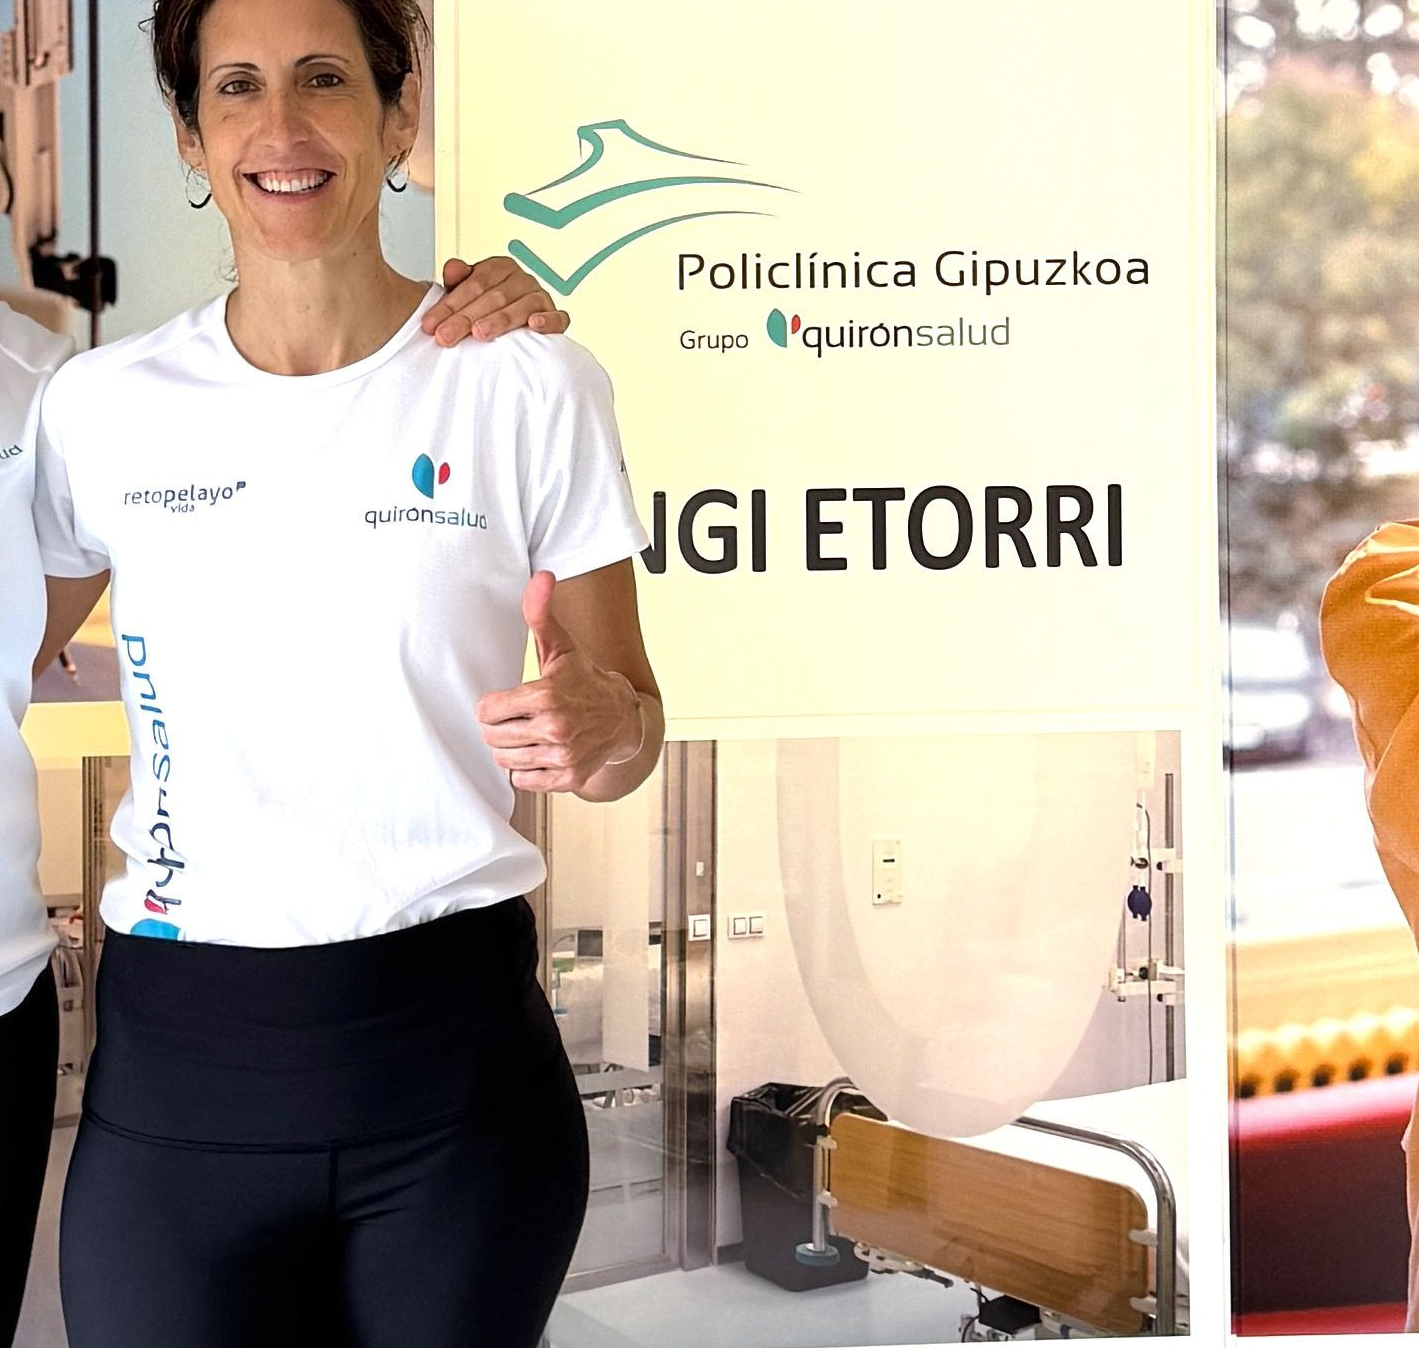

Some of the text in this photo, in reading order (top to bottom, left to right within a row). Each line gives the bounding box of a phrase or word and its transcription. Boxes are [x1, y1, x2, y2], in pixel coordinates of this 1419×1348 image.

[678, 250, 1150, 295] Policlínica Gipuzkoa
[680, 316, 1010, 358] Grupo quirónsalud
[124, 484, 233, 508] retopelayo
[638, 483, 1123, 575] NGI ETORRI
